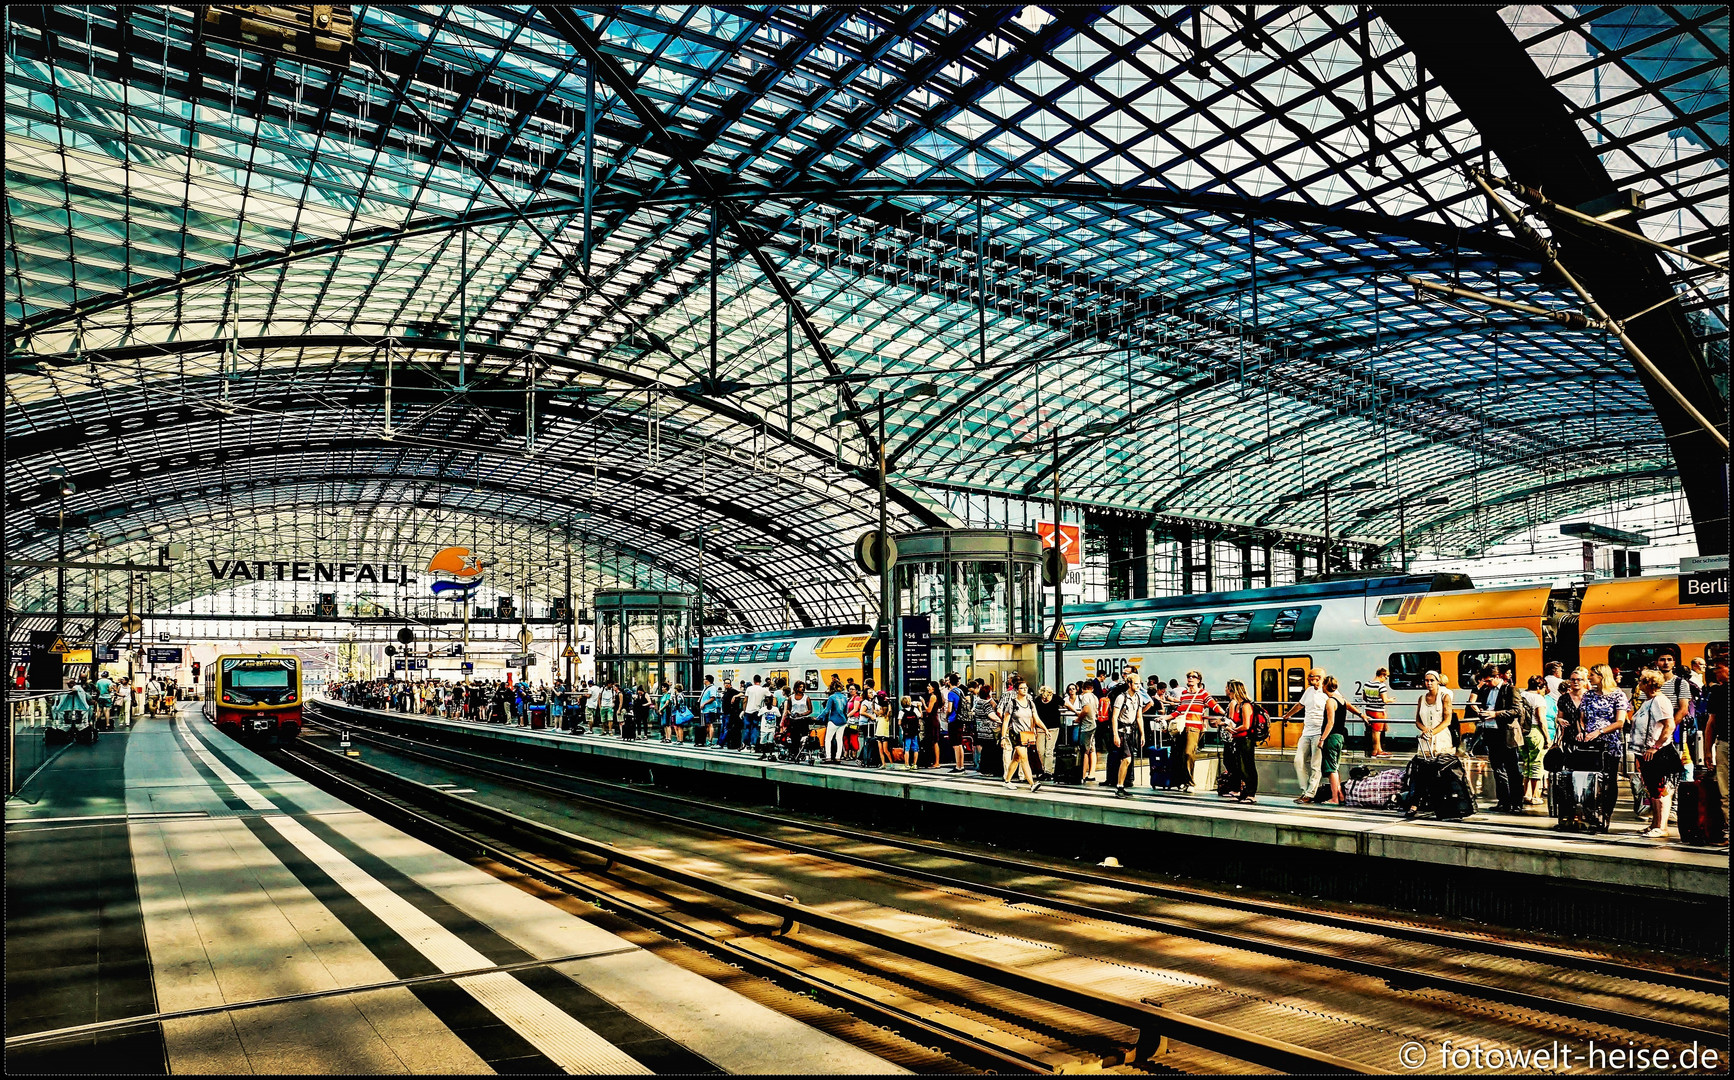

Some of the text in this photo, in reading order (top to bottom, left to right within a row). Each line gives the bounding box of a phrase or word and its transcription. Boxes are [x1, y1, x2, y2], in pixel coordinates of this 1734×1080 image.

[206, 559, 418, 585] VATTENFALL
[1062, 571, 1081, 585] CRO
[1688, 577, 1728, 595] Berli
[160, 632, 170, 641] 15
[1355, 681, 1363, 696] 2
[341, 730, 350, 741] H
